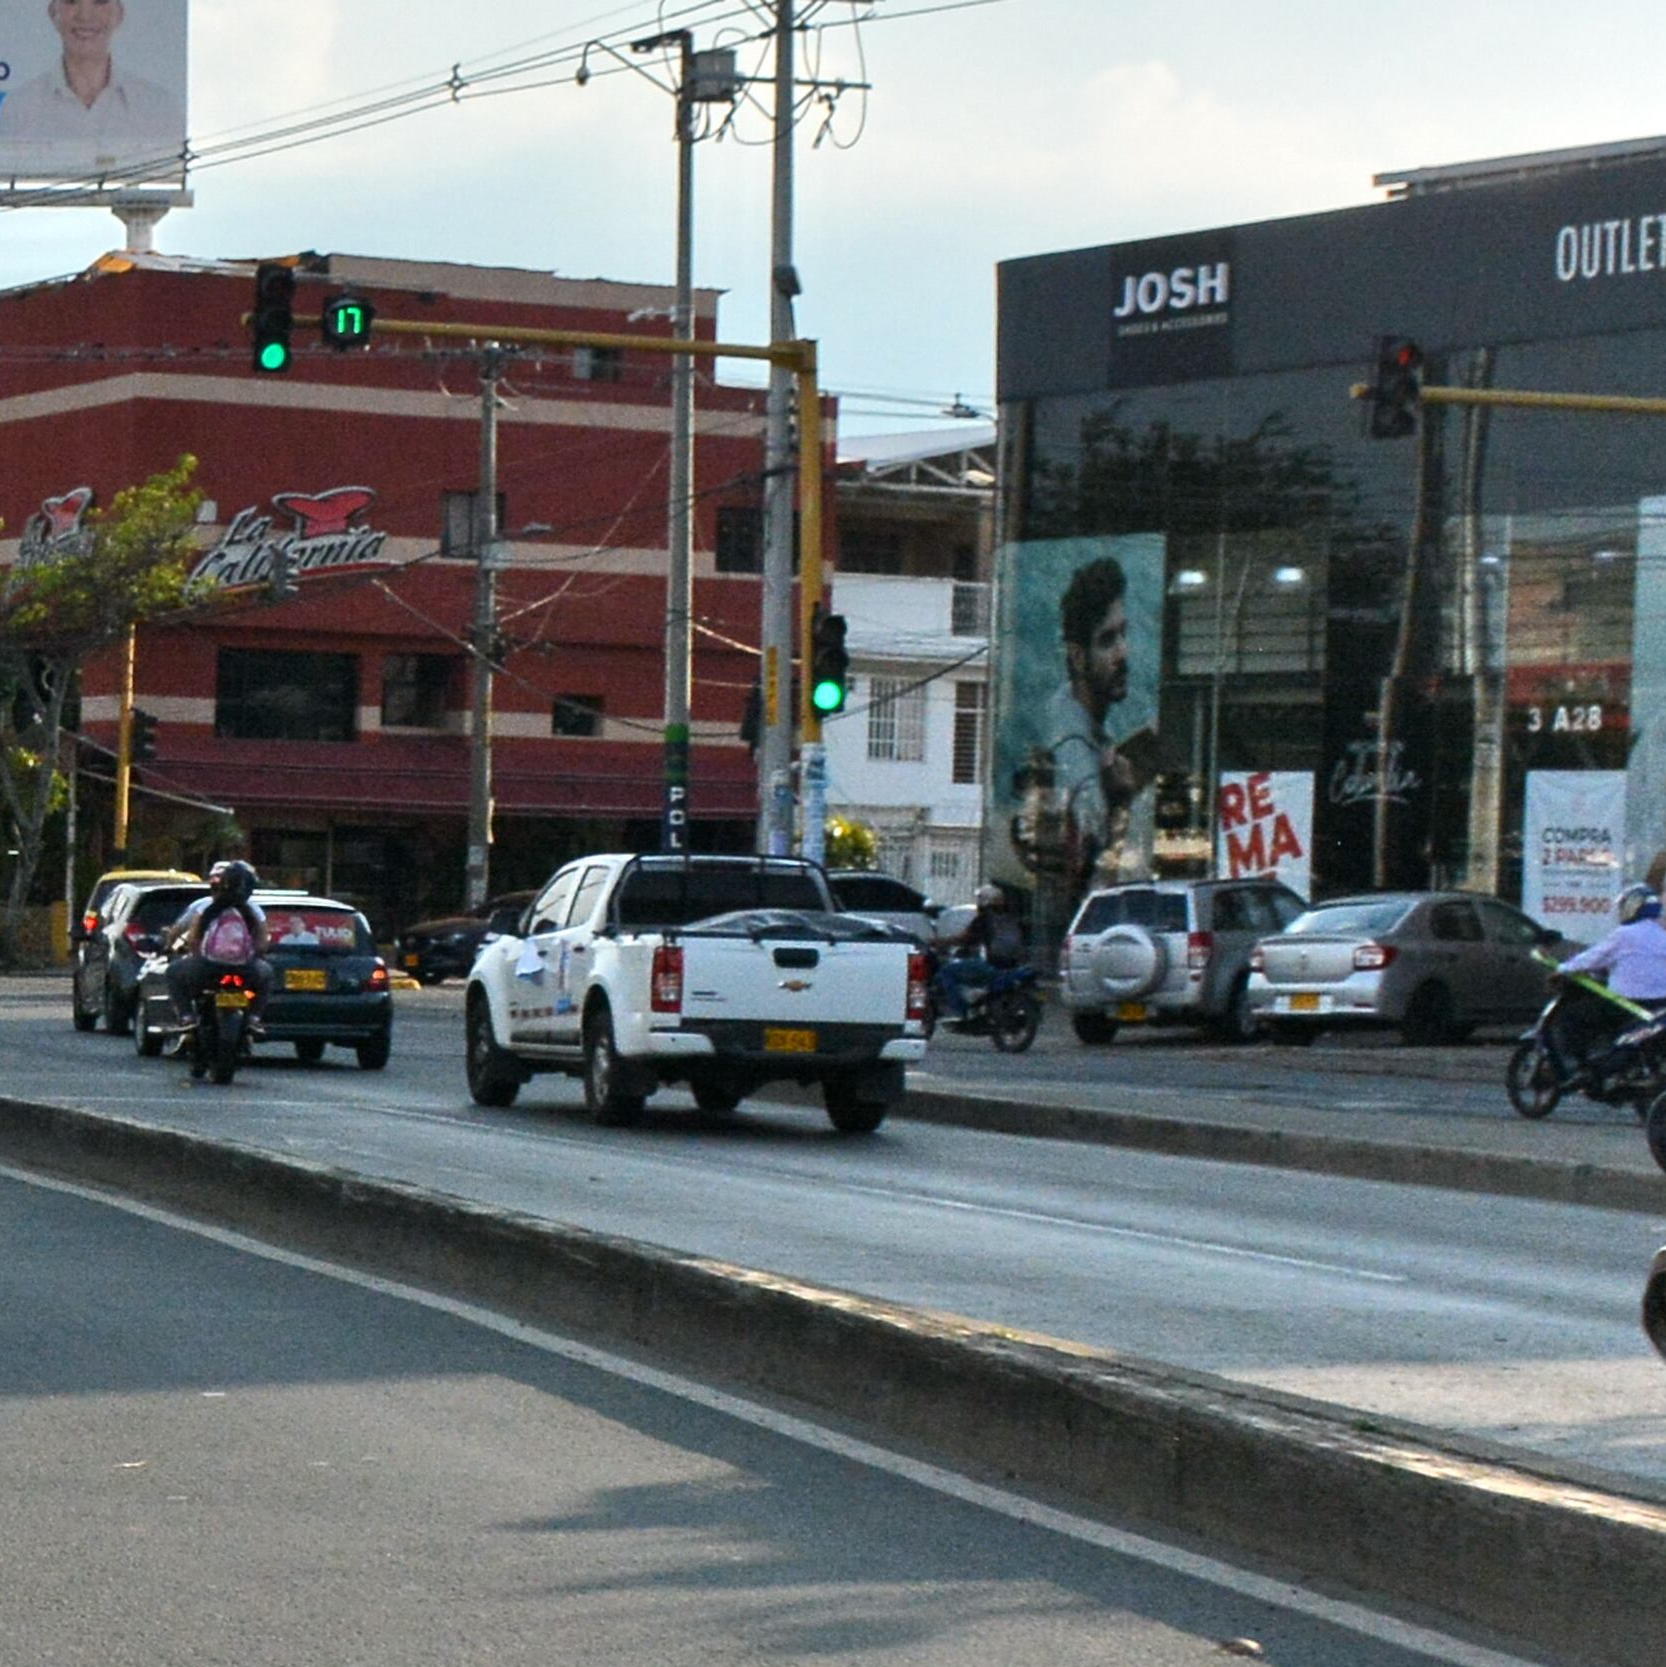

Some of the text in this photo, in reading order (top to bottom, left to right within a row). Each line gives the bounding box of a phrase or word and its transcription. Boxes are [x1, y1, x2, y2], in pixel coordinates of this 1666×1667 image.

[1113, 262, 1229, 316] JOSH
[337, 306, 362, 334] 17
[224, 505, 272, 547] La
[193, 525, 387, 594] Calirnia
[1218, 771, 1276, 831] RE
[1227, 812, 1304, 879] MA
[1542, 827, 1611, 843] COMPRA
[1556, 847, 1611, 867] PAR
